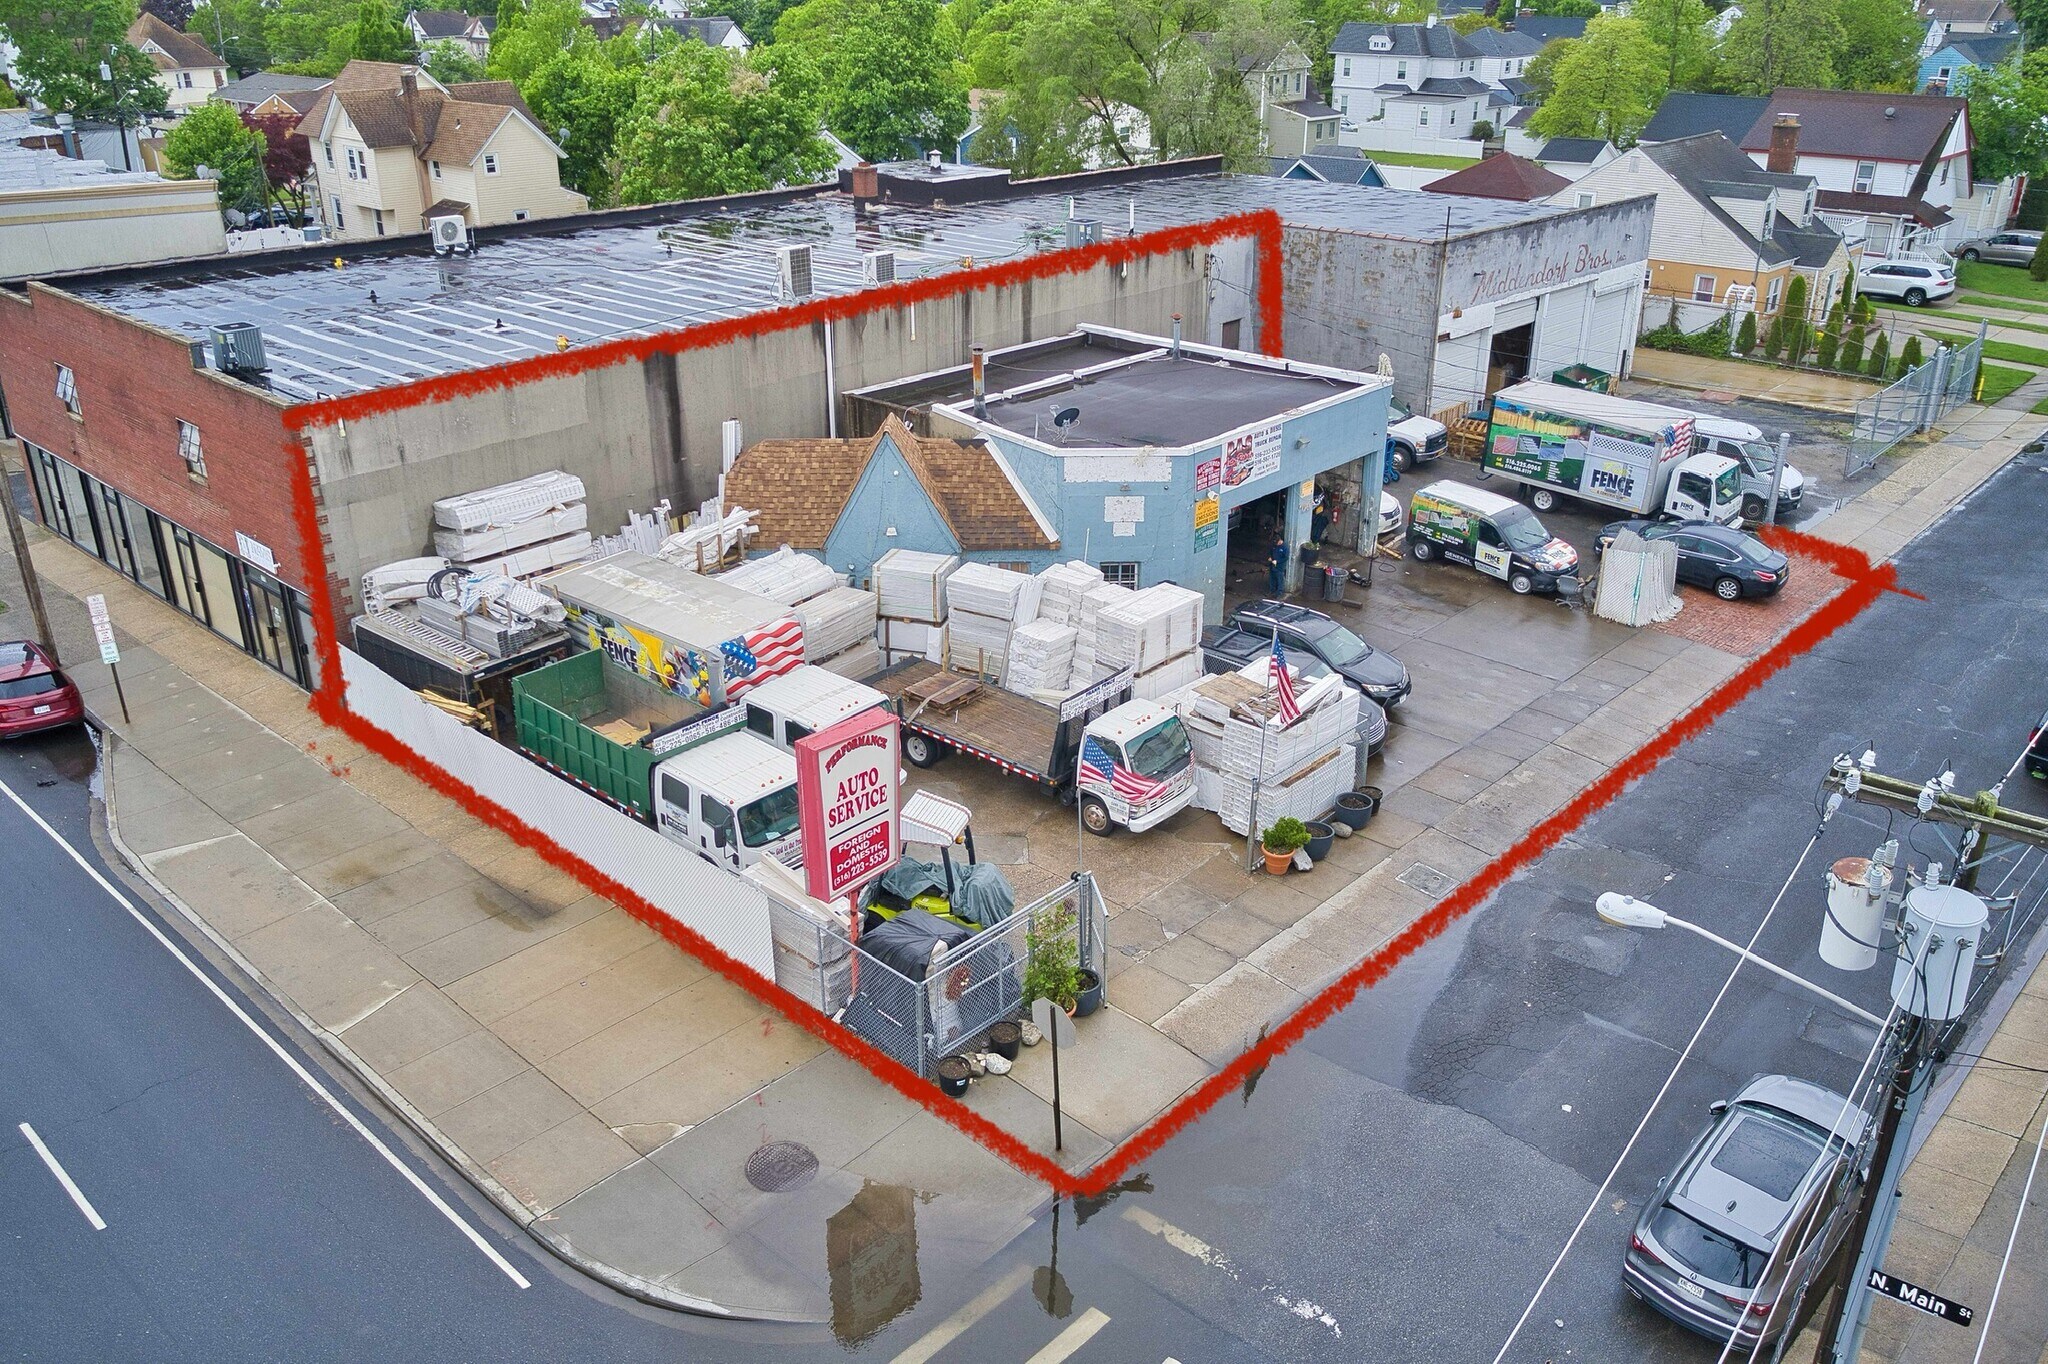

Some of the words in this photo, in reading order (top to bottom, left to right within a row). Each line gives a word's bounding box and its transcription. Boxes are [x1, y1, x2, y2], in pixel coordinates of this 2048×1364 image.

[1470, 252, 1569, 304] Middendorf
[1574, 244, 1612, 273] Bros.
[1254, 432, 1264, 440] AUTO
[1255, 437, 1268, 447] TRUCK
[1591, 469, 1634, 497] FENCE
[1445, 550, 1470, 563] GENERAL
[1484, 552, 1500, 564] FENCE
[600, 637, 639, 673] FENCE
[682, 722, 699, 733] FRANK
[701, 713, 719, 724] FENCE
[825, 735, 888, 774] PERFORMANCE
[836, 767, 879, 803] AUTO
[828, 784, 888, 828] SERVICE
[838, 826, 881, 853] FOREIGN
[849, 840, 870, 857] AND
[833, 870, 851, 886] (516)
[851, 848, 888, 877] 223-5539
[836, 841, 885, 873] DOMESTIC
[1871, 1272, 1889, 1291] N.
[1899, 1283, 1947, 1315] Main
[1959, 1307, 1972, 1318] St
